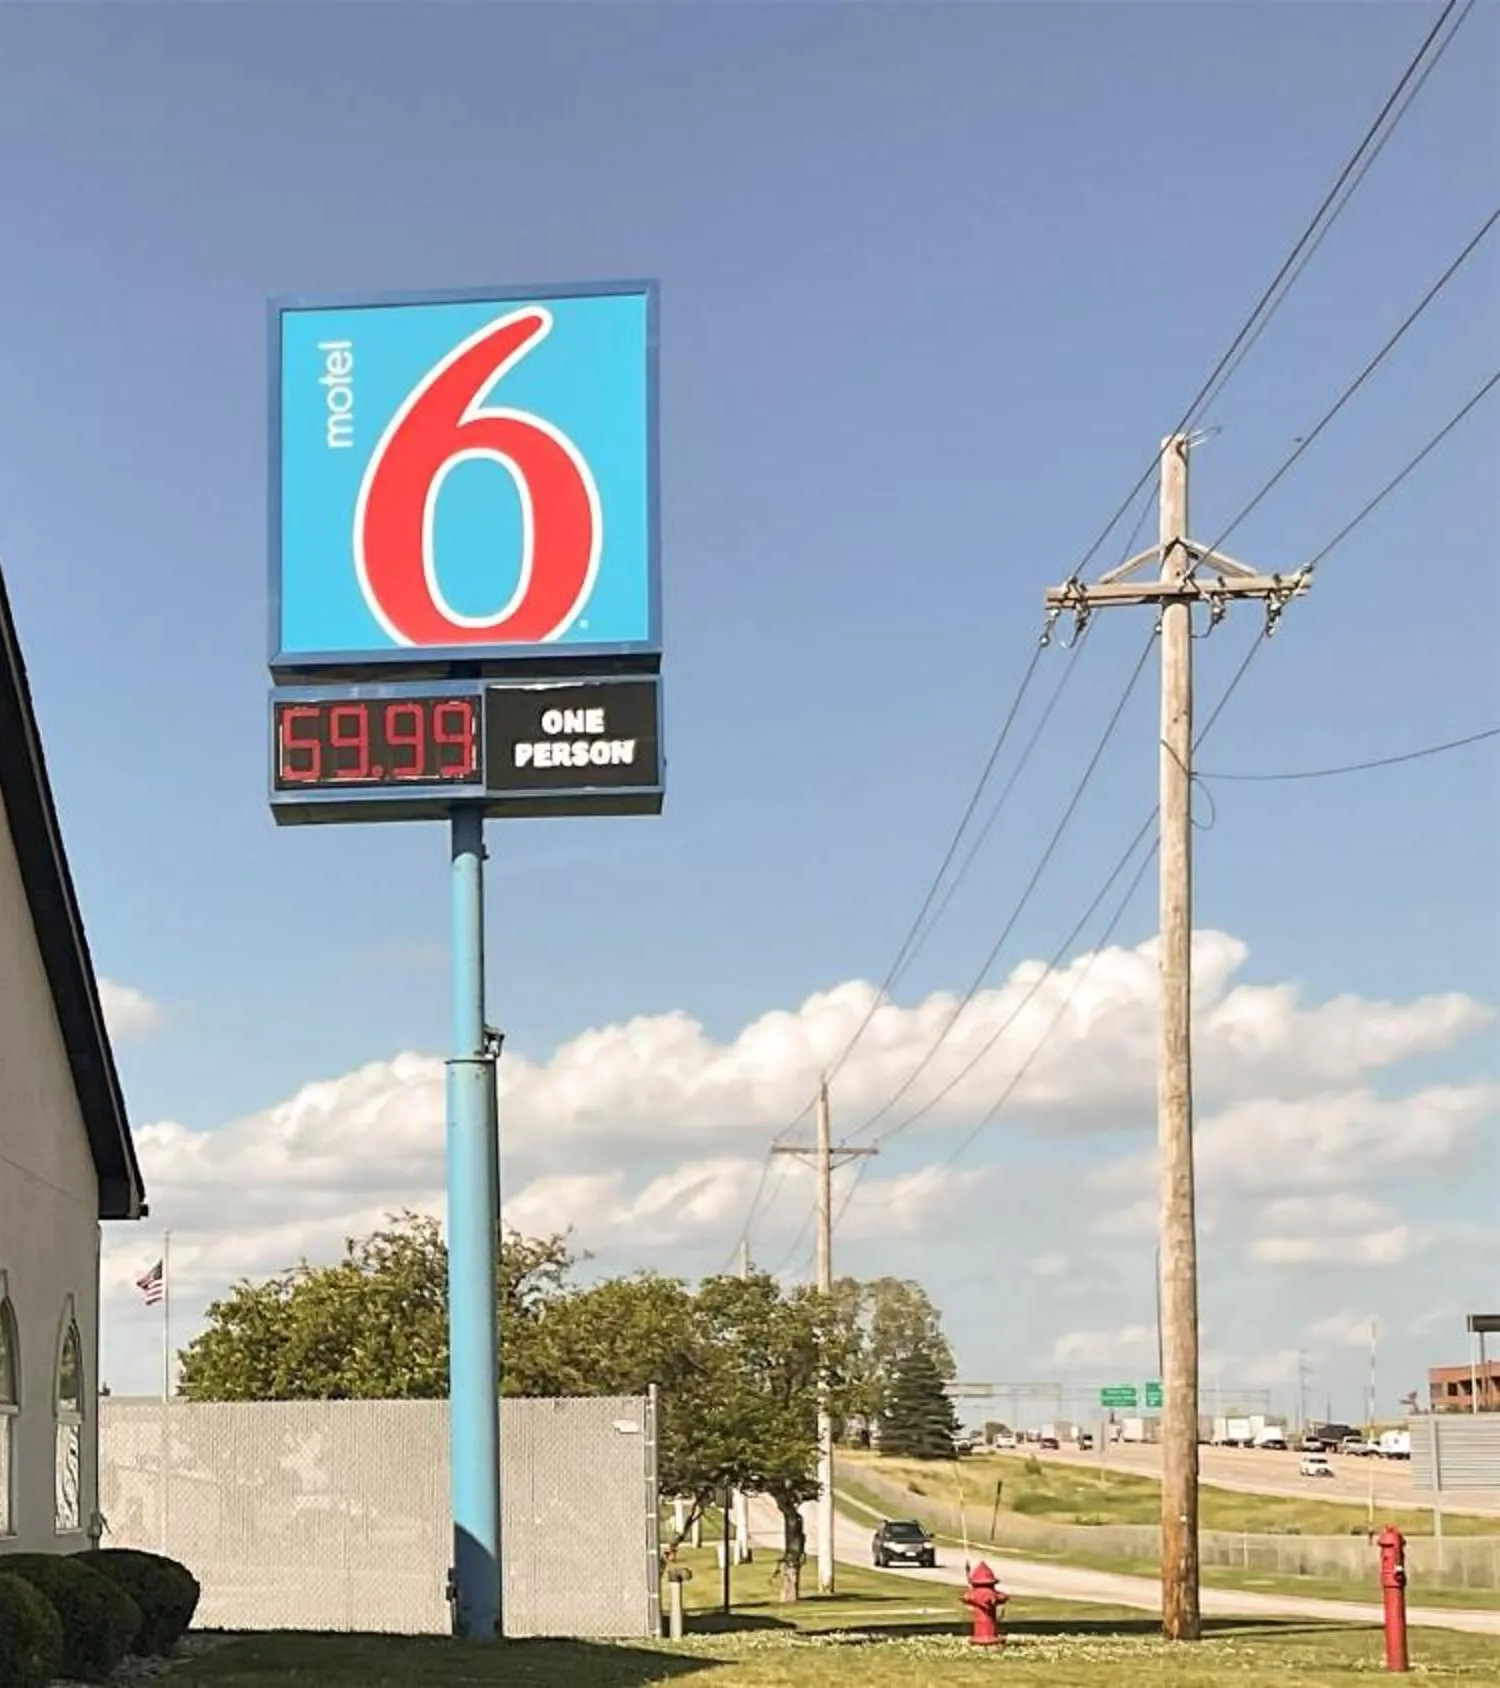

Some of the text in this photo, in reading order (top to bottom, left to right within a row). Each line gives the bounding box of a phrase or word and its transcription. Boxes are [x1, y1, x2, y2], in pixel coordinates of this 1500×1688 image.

[317, 341, 354, 448] motel
[353, 306, 603, 648] 6
[280, 702, 474, 781] 59.99
[514, 739, 635, 768] PERSON
[541, 708, 605, 735] ONE
